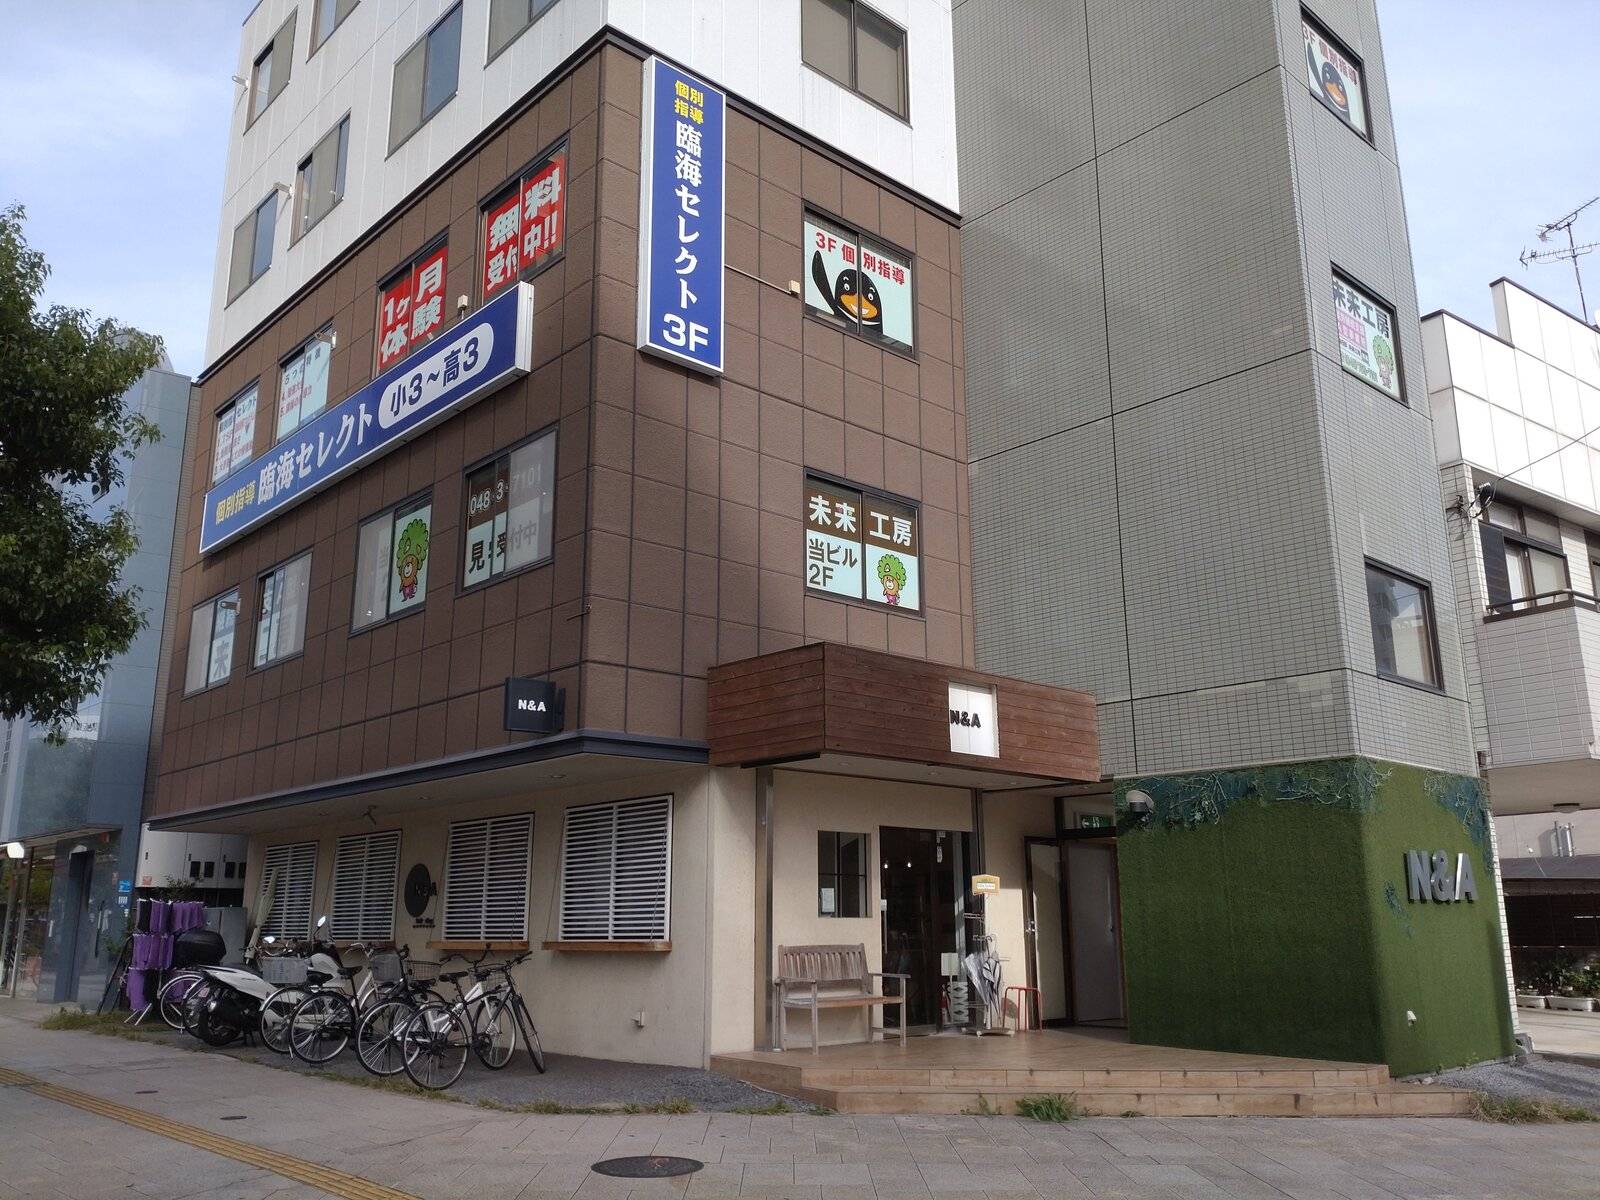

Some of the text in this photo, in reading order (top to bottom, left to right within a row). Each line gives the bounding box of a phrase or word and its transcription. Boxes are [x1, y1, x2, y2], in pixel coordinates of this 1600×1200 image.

[674, 79, 704, 108] 個別
[674, 98, 705, 126] 指導
[489, 166, 562, 252] 無料
[674, 119, 703, 310] 臨海セレクト
[815, 231, 837, 253] 3F
[841, 243, 905, 286] 個別指導
[380, 294, 443, 364] 体験
[662, 312, 710, 352] 3F
[215, 480, 256, 526] 個別指導
[257, 402, 373, 505] 臨海セレクト
[808, 494, 913, 548] 未来工房
[808, 537, 859, 569] 当ビル
[808, 563, 834, 587] 2F
[518, 699, 546, 712] N&A
[950, 709, 981, 729] N&A
[1405, 850, 1479, 903] N&A
